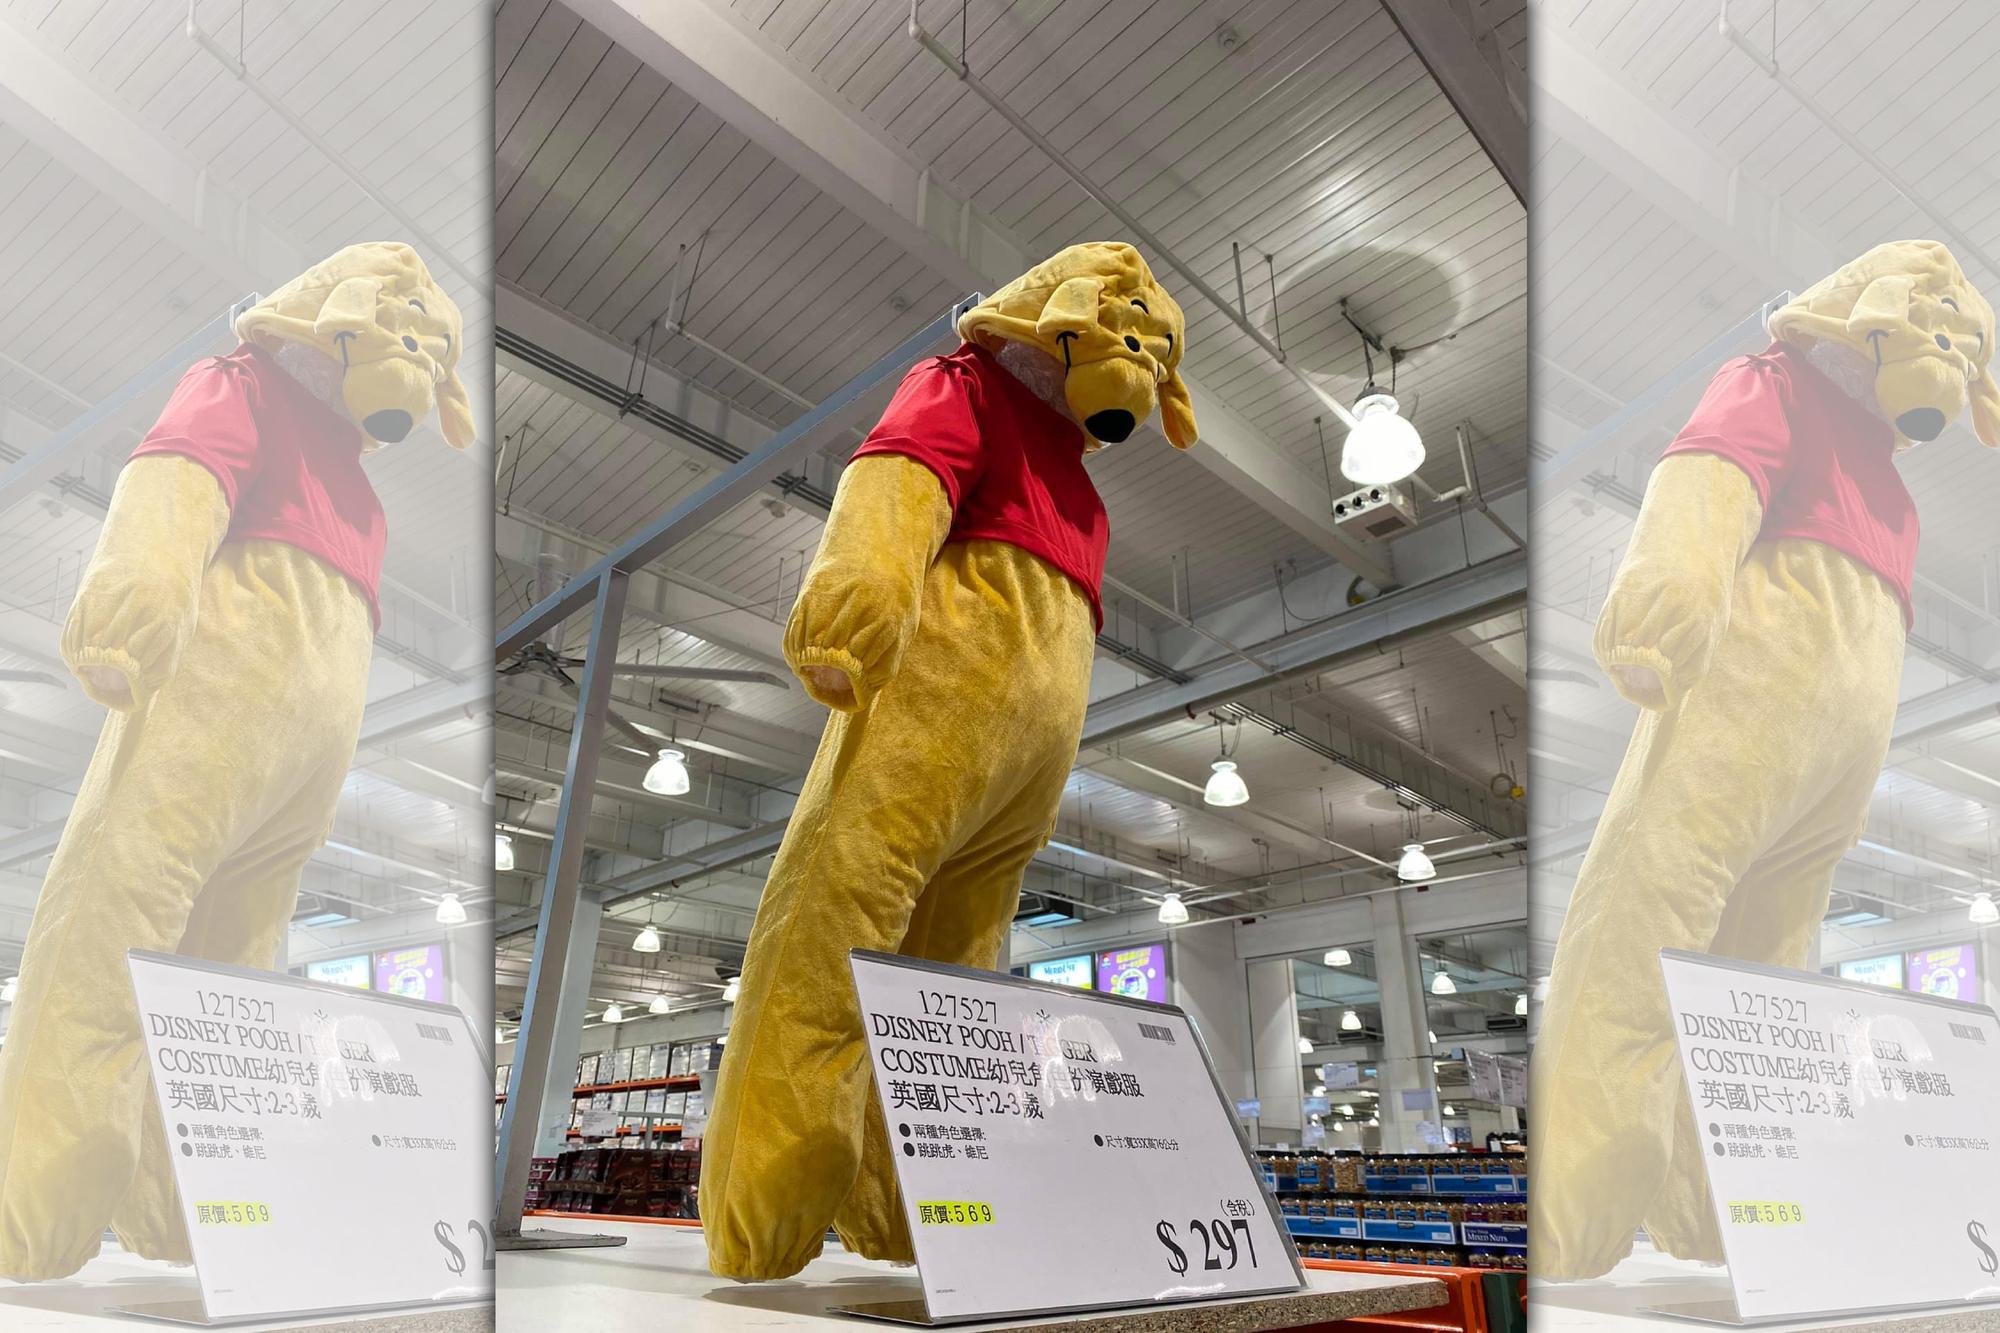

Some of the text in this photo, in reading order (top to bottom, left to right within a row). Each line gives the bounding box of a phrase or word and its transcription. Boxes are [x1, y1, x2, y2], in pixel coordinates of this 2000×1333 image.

[196, 989, 274, 1024] 127527
[918, 989, 996, 1024] 127527
[1728, 988, 1806, 1023] 127527
[148, 1013, 232, 1045] DISNEY
[235, 1025, 295, 1053] POOH
[870, 1013, 954, 1045] DISNEY
[957, 1025, 1017, 1053] POOH
[1027, 1034, 1098, 1062] TGER
[1680, 1012, 1764, 1044] DISNEY
[1767, 1024, 1827, 1052] POOH
